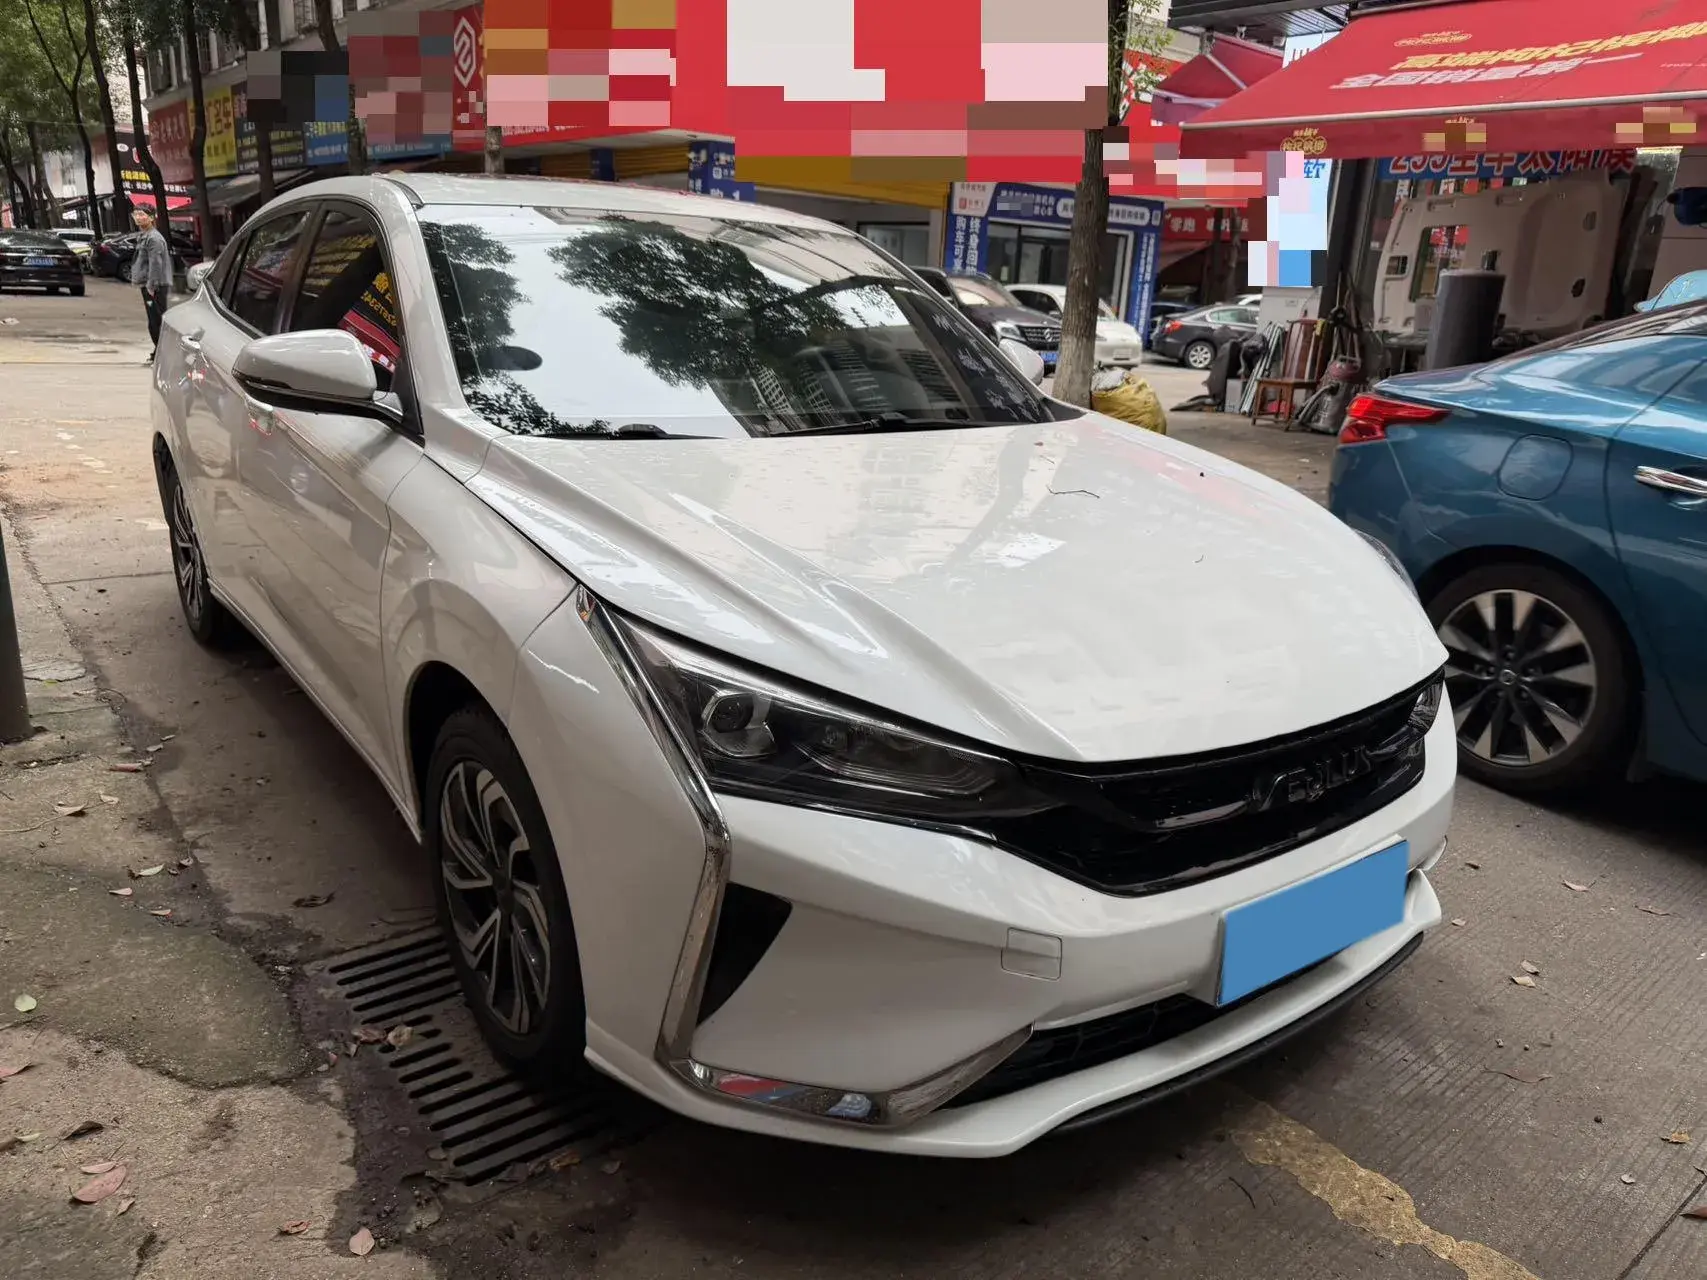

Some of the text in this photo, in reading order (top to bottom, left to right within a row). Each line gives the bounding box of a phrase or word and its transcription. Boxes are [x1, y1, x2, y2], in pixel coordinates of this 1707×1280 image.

[1329, 52, 1644, 90] 全国销量第一
